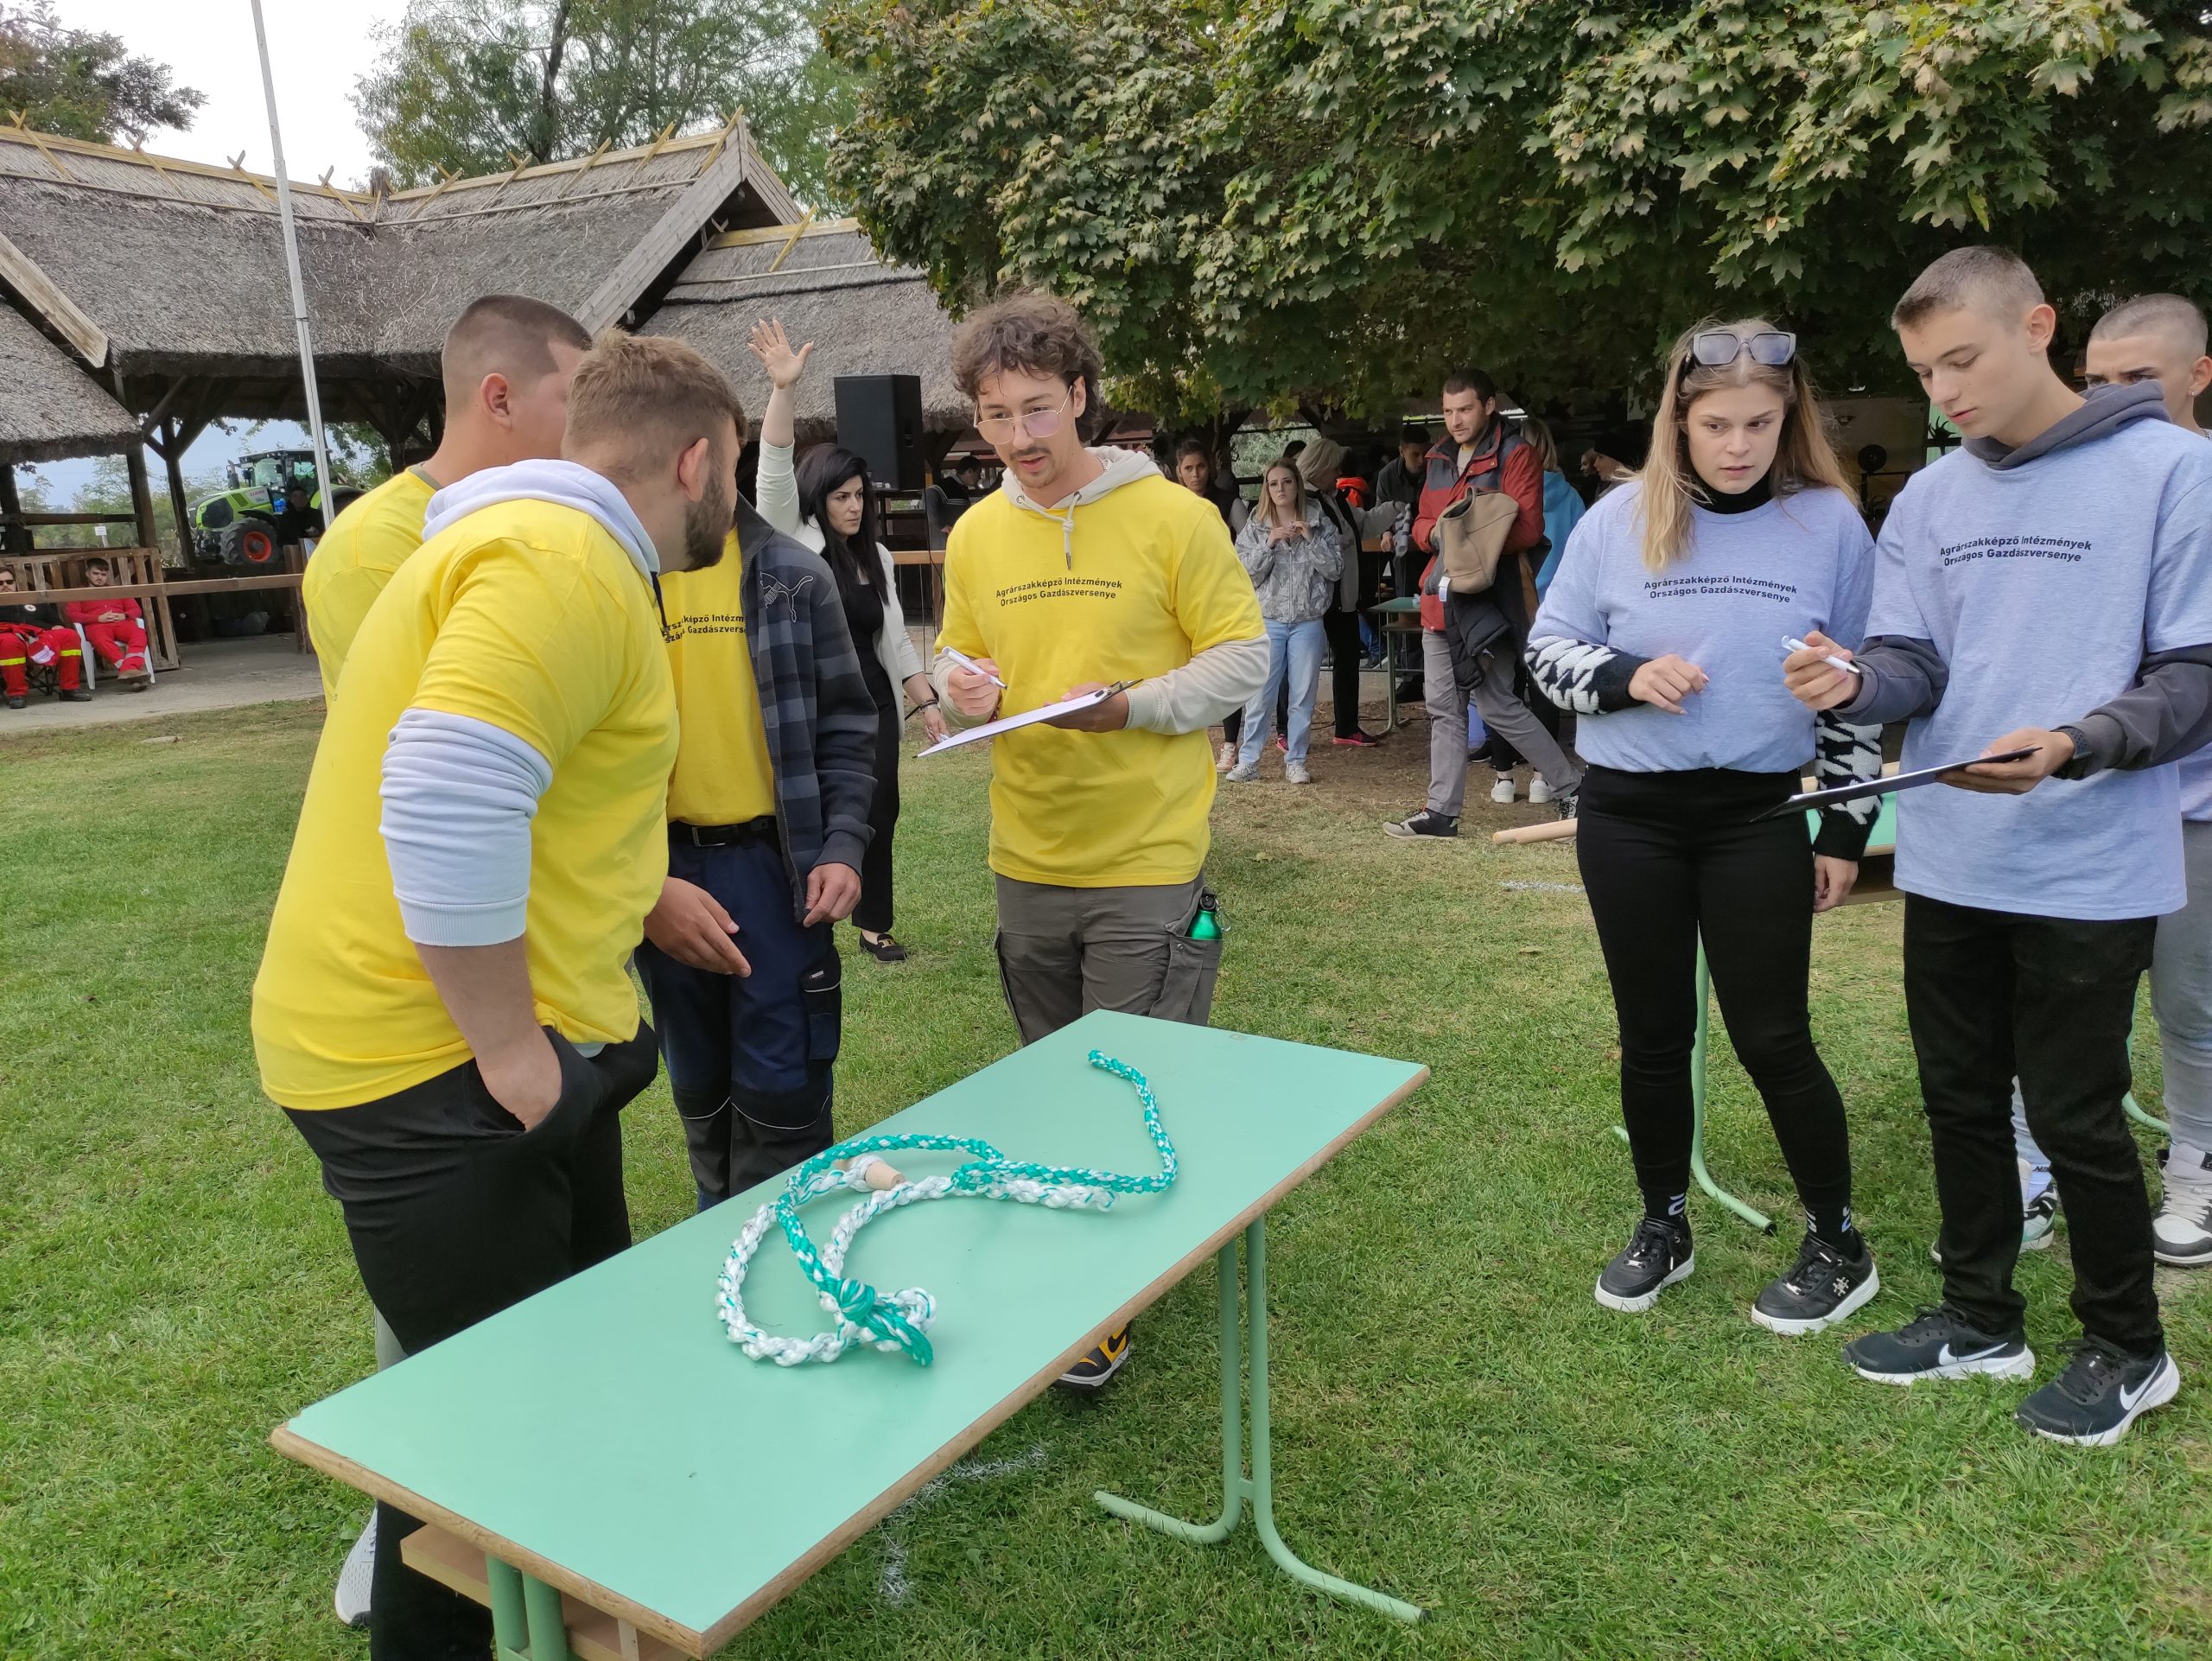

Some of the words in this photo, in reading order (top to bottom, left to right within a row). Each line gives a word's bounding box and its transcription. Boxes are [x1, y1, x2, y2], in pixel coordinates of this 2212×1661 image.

[1940, 536, 2019, 557] Agrárszakképző
[2021, 535, 2092, 550] Intézmények
[1944, 551, 1984, 567] Országos
[1986, 548, 2082, 563] Gazdászversenye
[995, 577, 1063, 598] Agrárszakképző
[1065, 577, 1122, 589] Intézmények
[1643, 575, 1730, 590] Agrárszakképző
[1732, 576, 1797, 595] Intézmények
[1649, 589, 1697, 599] Országos
[1700, 586, 1790, 603] Gazdászversenye
[1001, 593, 1038, 607] Országos
[1039, 589, 1116, 599] Gazdászversenye
[712, 614, 744, 622] Intézm
